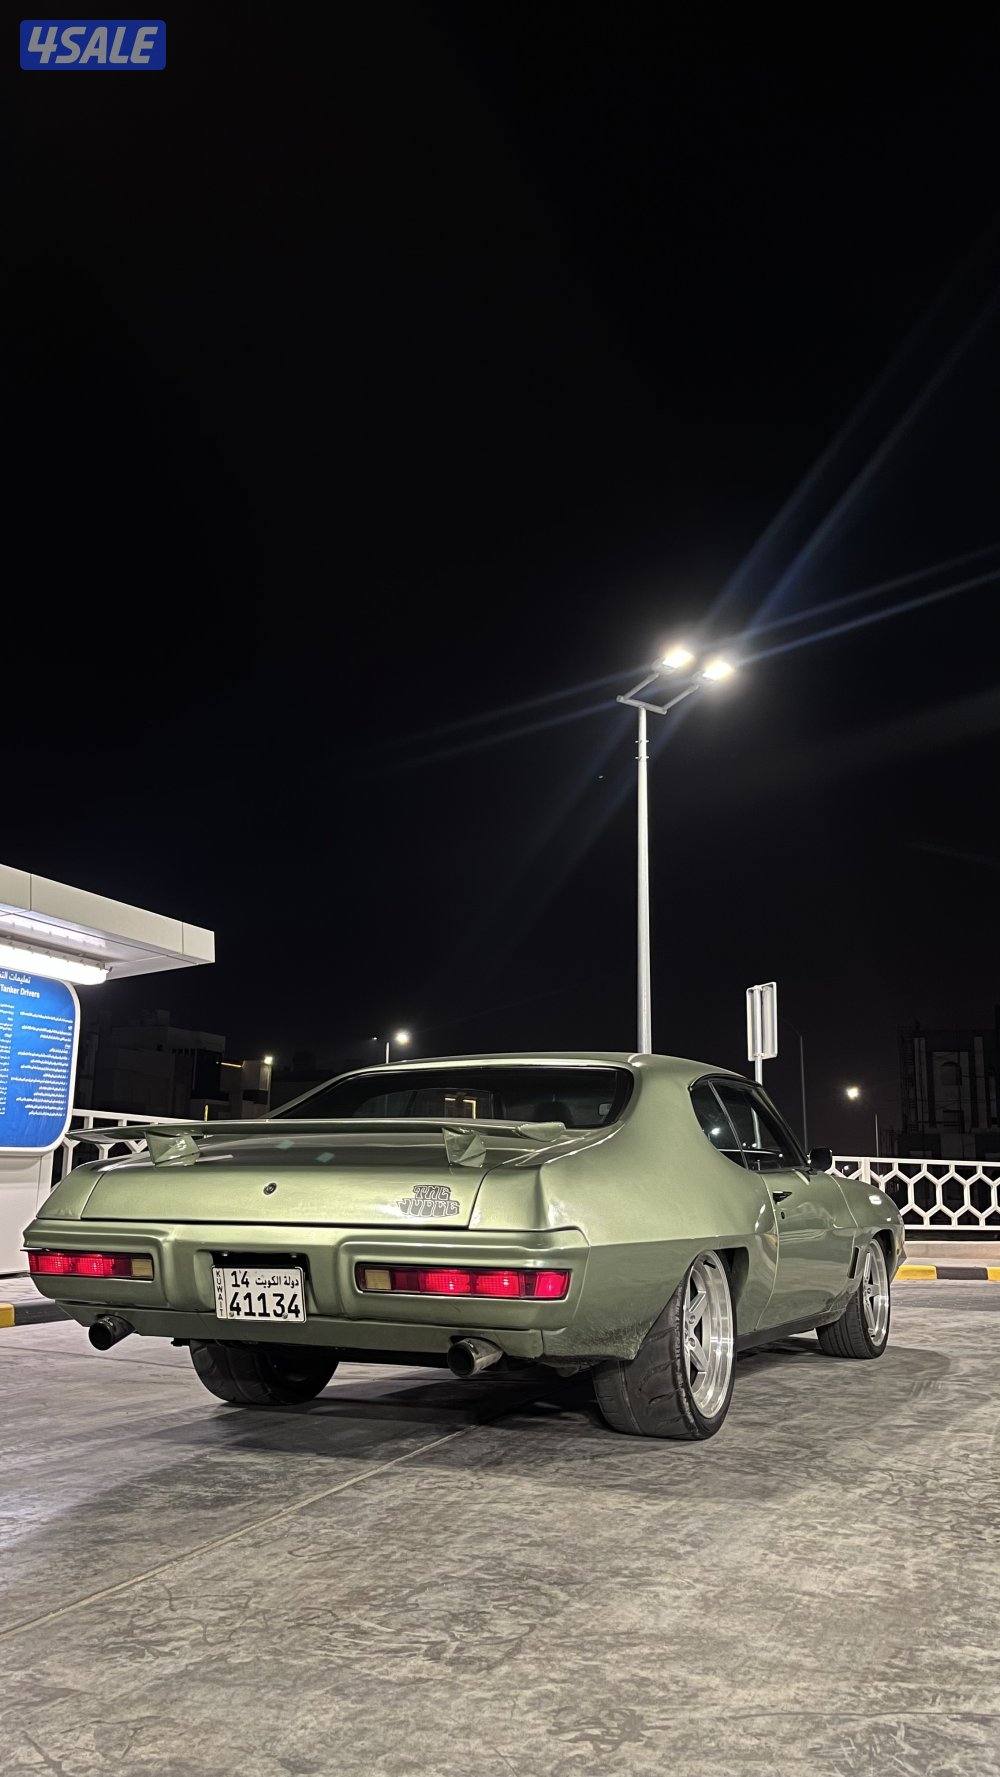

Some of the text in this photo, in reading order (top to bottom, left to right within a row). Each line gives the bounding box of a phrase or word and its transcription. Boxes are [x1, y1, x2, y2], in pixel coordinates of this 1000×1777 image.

[0, 983, 40, 999] Tanker Drivers
[413, 1184, 452, 1200] THE
[231, 1270, 250, 1288] 14
[255, 1275, 300, 1289] دولة الكويت
[215, 1270, 223, 1317] KUWAIT
[229, 1292, 301, 1318] 41134
